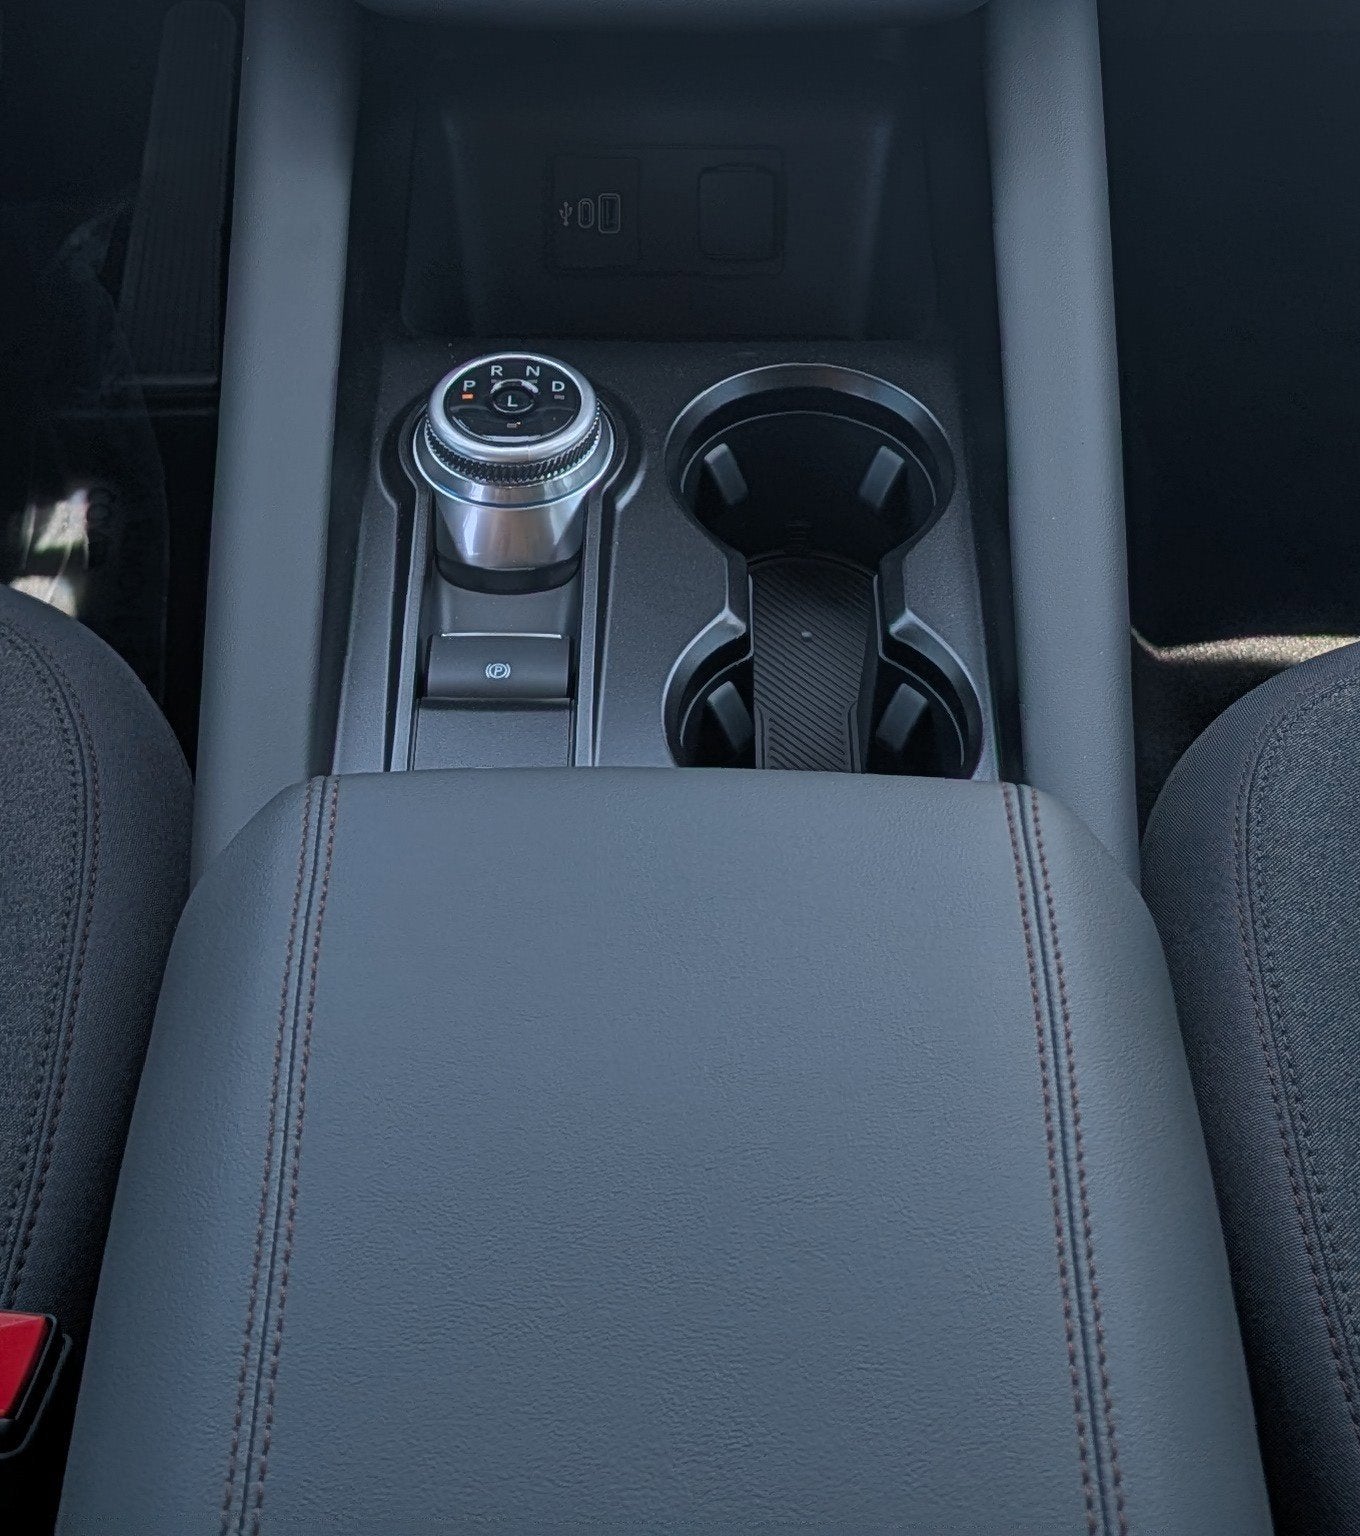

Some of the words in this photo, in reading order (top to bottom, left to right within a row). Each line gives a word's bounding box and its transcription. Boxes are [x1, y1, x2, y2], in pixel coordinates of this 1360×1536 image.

[490, 366, 503, 376] R
[526, 366, 540, 376] N
[462, 380, 476, 392] P
[552, 381, 566, 392] D
[507, 395, 518, 408] L
